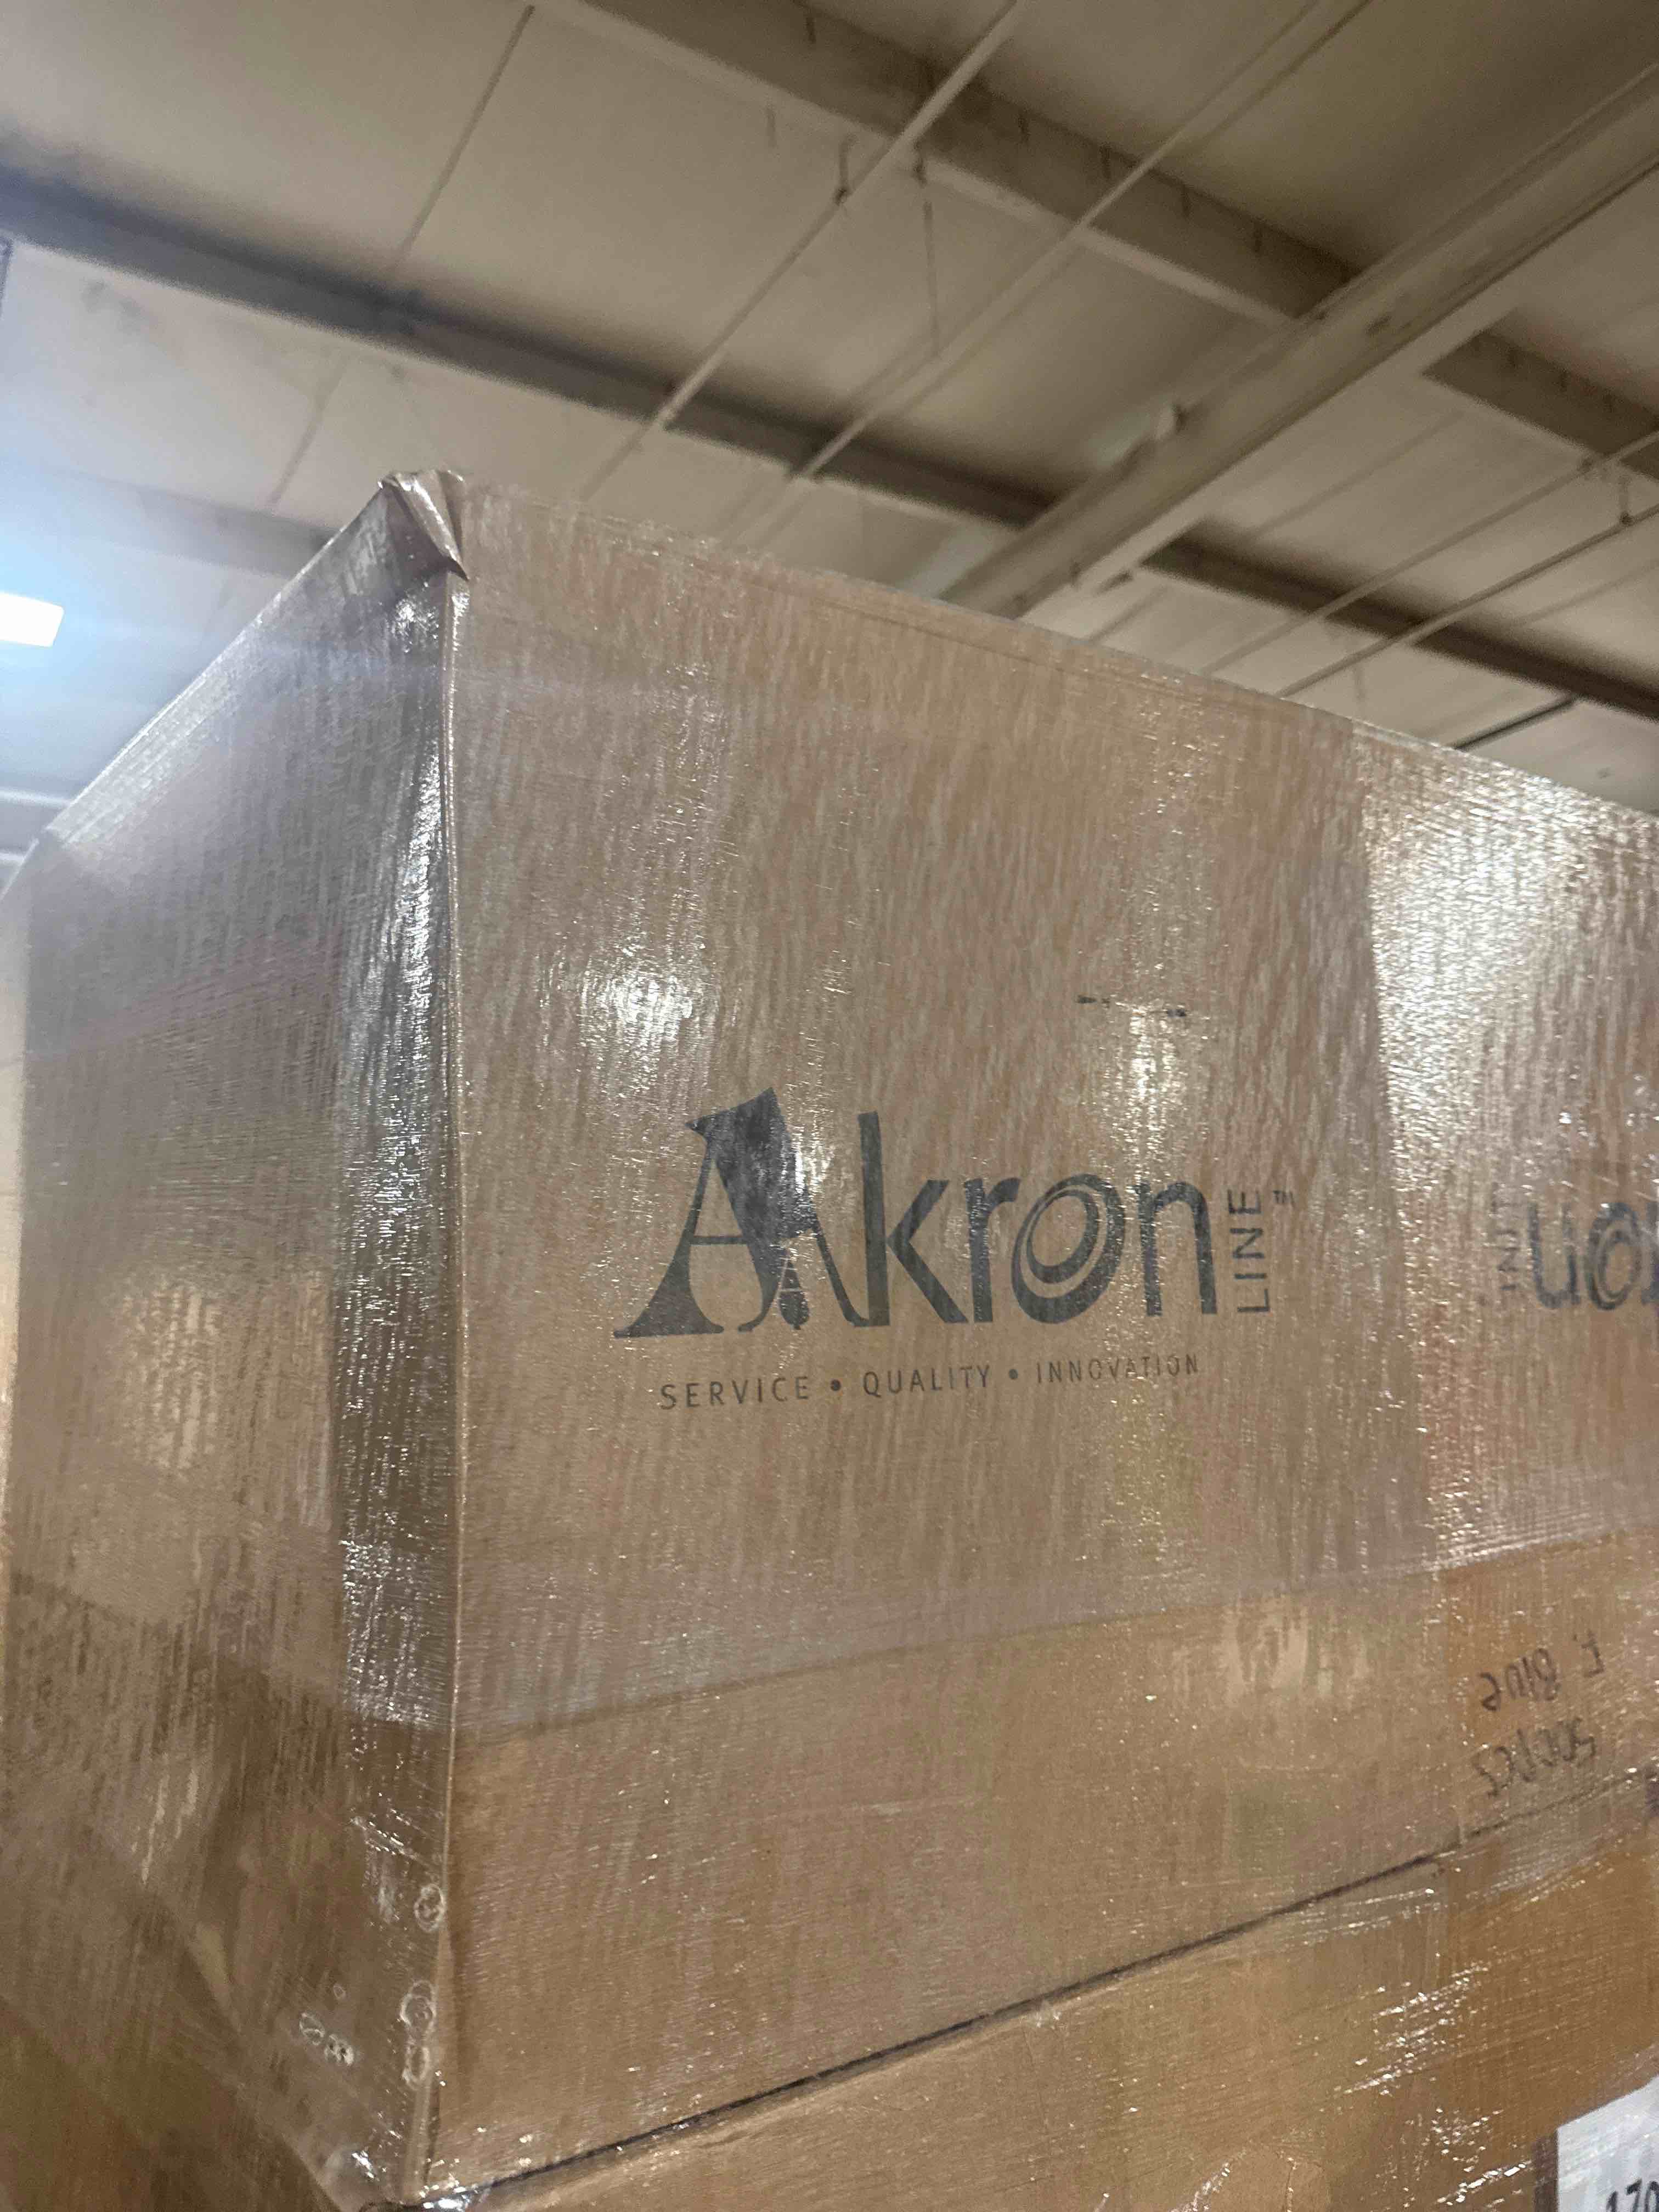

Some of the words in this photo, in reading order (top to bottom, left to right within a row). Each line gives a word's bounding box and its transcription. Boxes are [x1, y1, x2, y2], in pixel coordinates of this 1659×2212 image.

[613, 1087, 1218, 1339] Akron
[1227, 1188, 1271, 1313] LINE
[660, 1375, 810, 1410] SERVICE
[862, 1364, 990, 1398] QUALITY
[1036, 1353, 1199, 1384] INNOVATION
